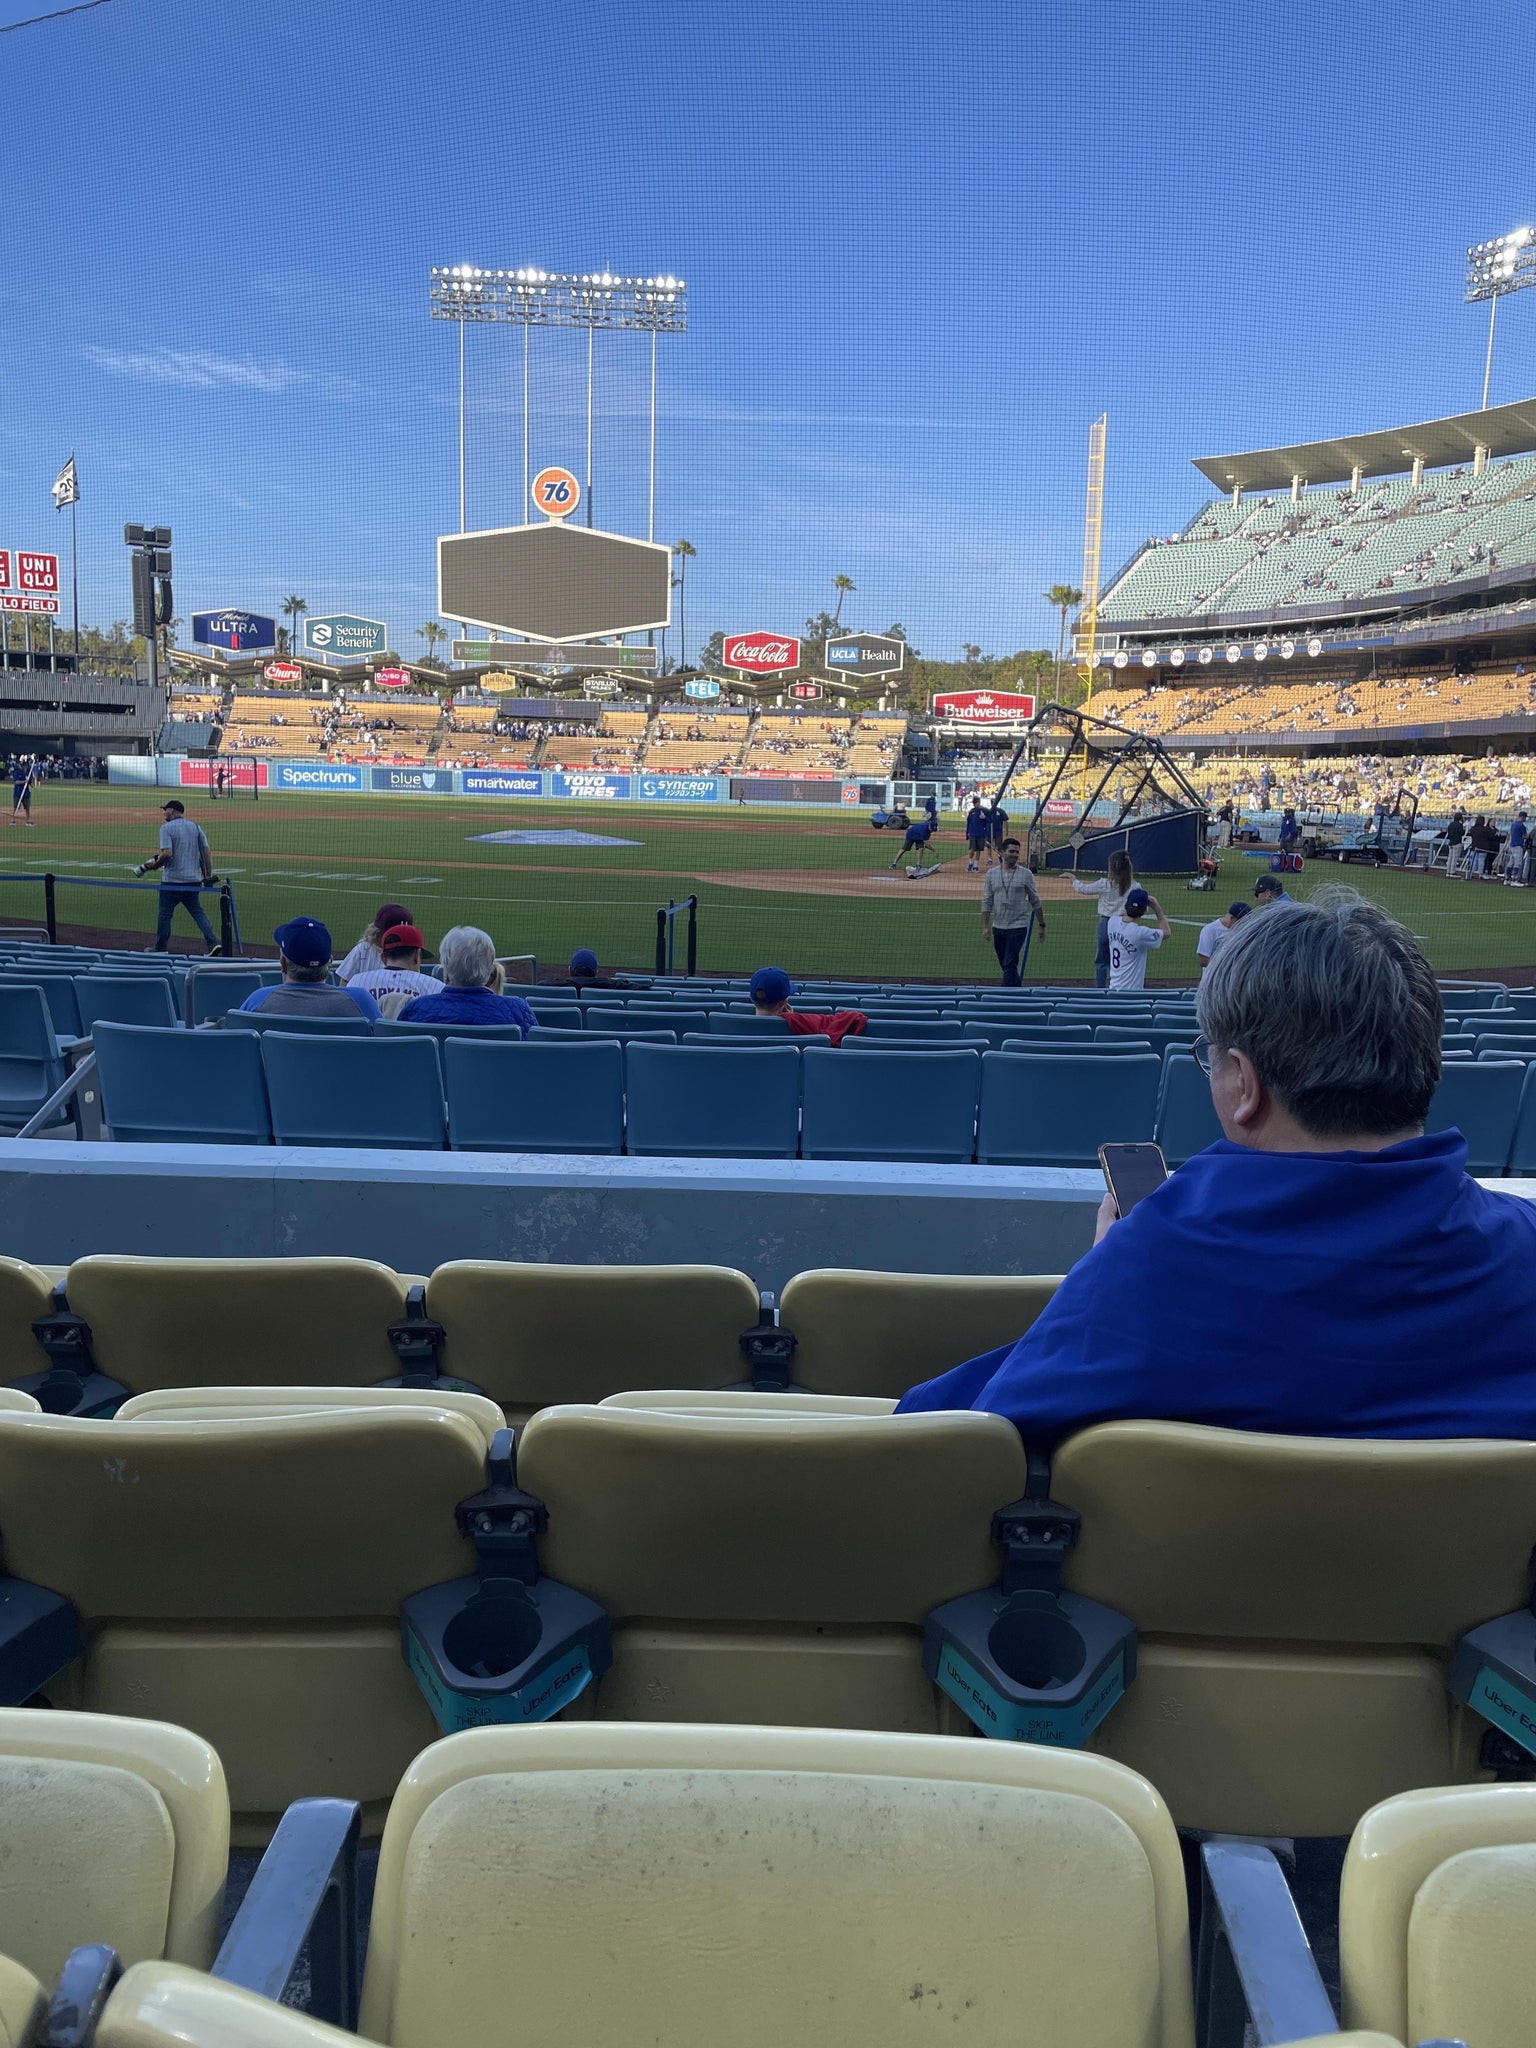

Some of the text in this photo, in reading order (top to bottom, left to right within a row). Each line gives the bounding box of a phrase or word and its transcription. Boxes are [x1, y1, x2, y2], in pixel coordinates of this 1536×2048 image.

[543, 480, 571, 503] 76
[22, 557, 51, 572] UNI
[24, 572, 54, 588] QLO
[21, 599, 56, 611] FIELD
[210, 620, 259, 634] ULTRA
[336, 624, 379, 639] Security
[336, 636, 374, 648] Benefit
[730, 641, 793, 663] Coca-Cola
[831, 649, 897, 661] UCLA Health
[689, 681, 716, 696] TEL
[282, 768, 351, 785] Spectrum
[391, 771, 421, 785] blue
[466, 777, 539, 790] smartwater
[563, 775, 606, 786] TOYO
[570, 786, 616, 798] TIRES
[657, 780, 714, 791] SYNCRON
[844, 789, 857, 799] 76
[1112, 947, 1120, 969] 8
[522, 1663, 584, 1716] Uber Eats
[946, 1662, 998, 1722] Uber Eats
[1080, 1672, 1120, 1728] Uber Eats
[1484, 1685, 1518, 1718] Uber
[466, 1707, 492, 1717] SKIP
[456, 1716, 478, 1726] THE
[1028, 1720, 1053, 1729] SKIP
[1016, 1728, 1065, 1741] THE LINE
